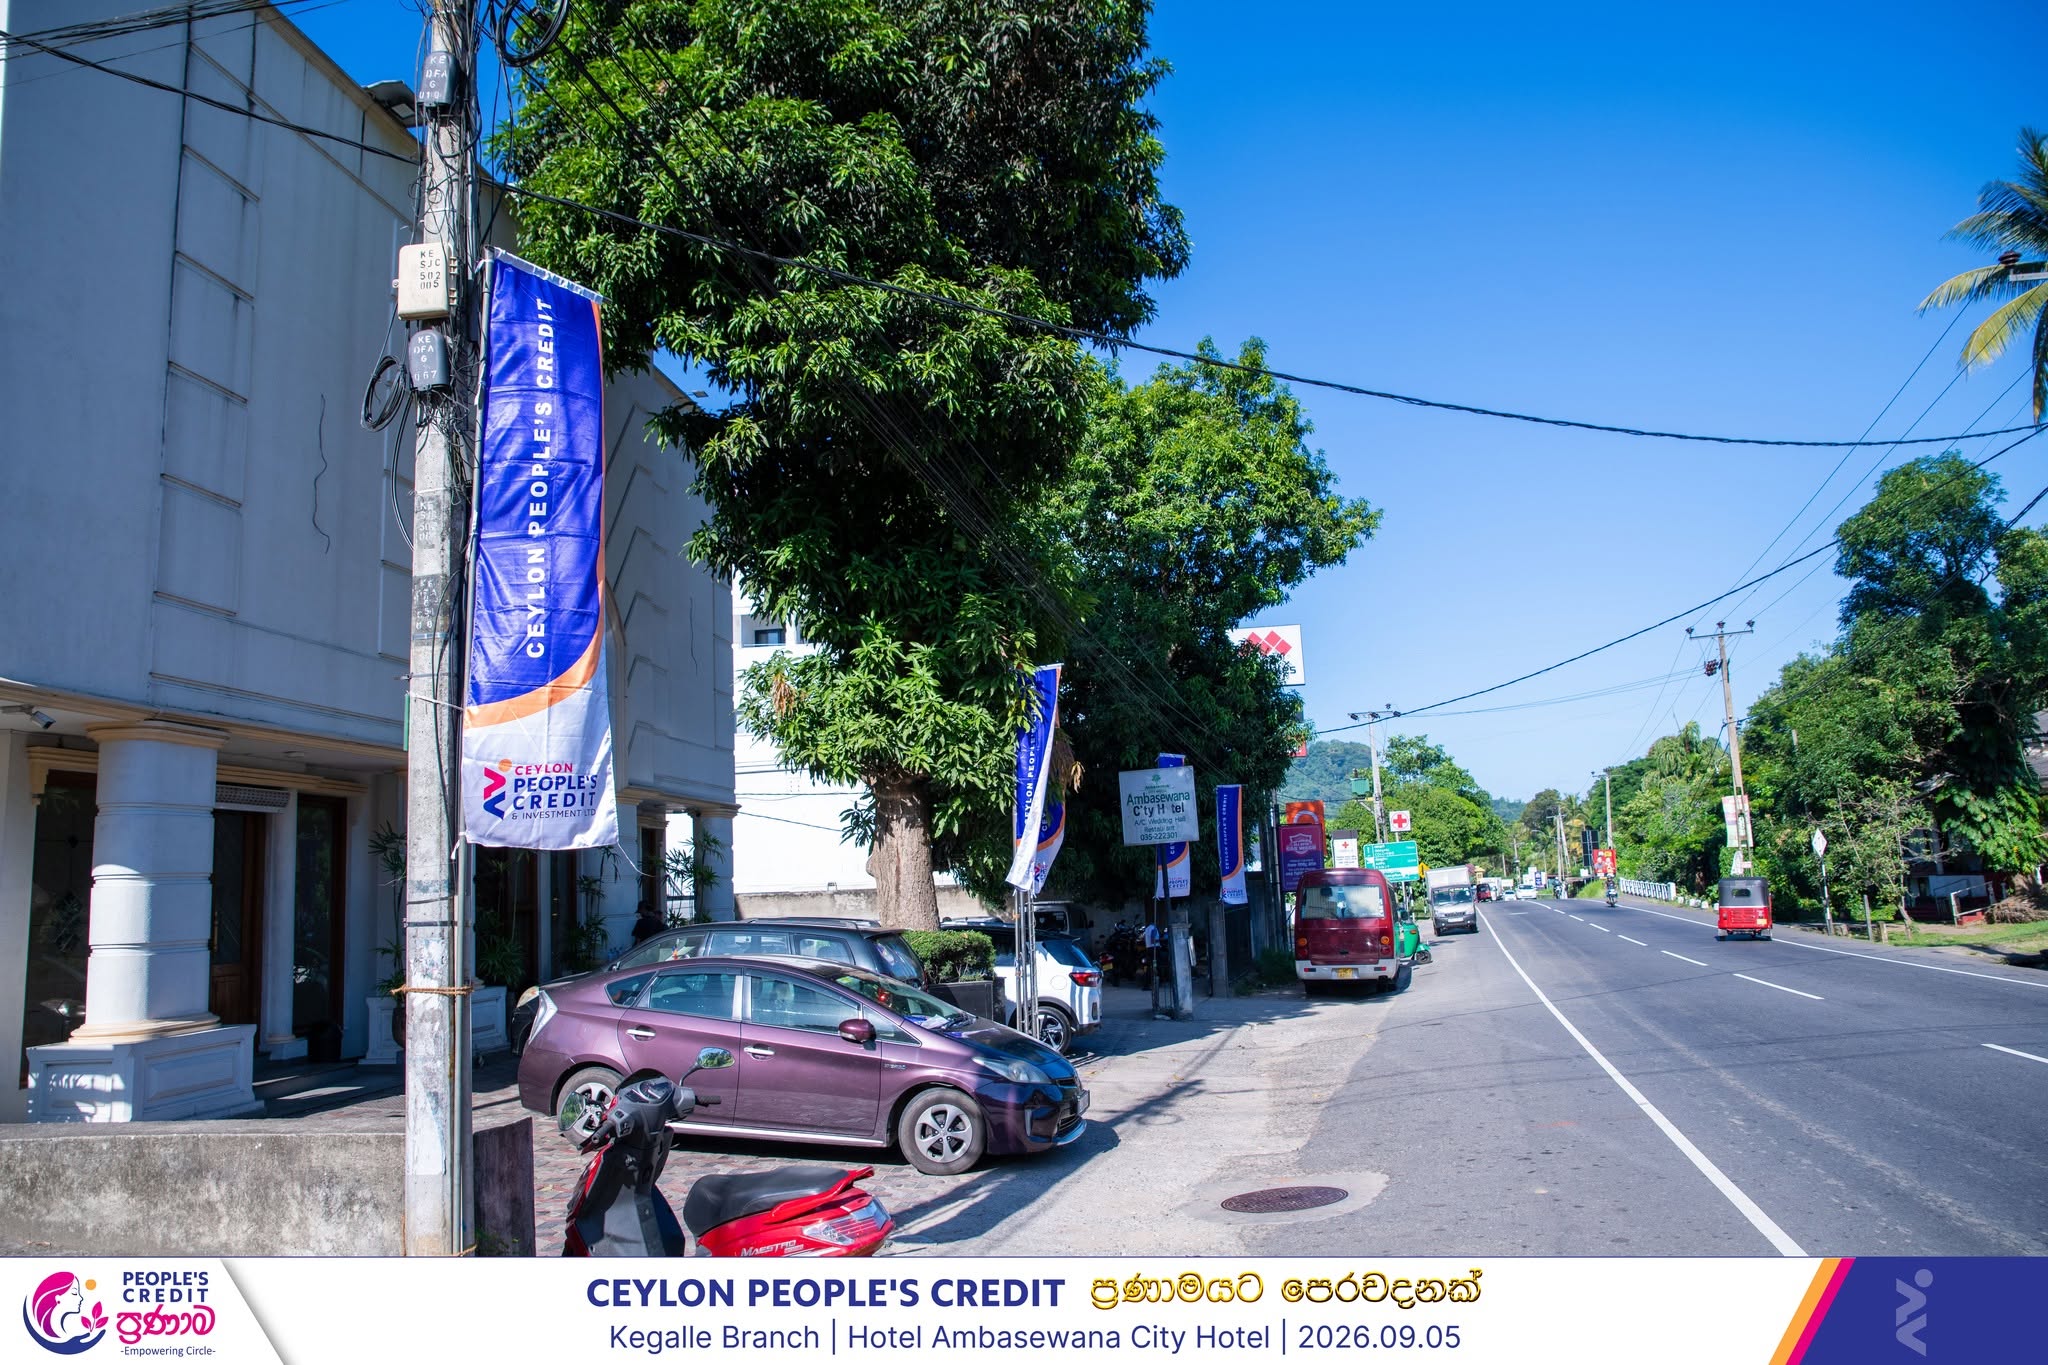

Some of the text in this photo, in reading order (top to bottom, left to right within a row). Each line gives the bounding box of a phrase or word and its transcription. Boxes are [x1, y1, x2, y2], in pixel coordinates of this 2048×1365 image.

[430, 54, 447, 65] KE
[420, 250, 434, 259] KE
[420, 259, 441, 269] SJC
[420, 271, 441, 280] 502
[418, 335, 431, 344] KE
[526, 297, 554, 659] CEYLON PEOPLE'S CREDIT
[515, 763, 573, 776] CEYLON
[513, 774, 598, 793] PEOPLE'S
[512, 792, 596, 811] CREDIT
[1126, 791, 1190, 806] Ambasewana
[511, 808, 597, 820] & INVESTMENT LTD
[1157, 802, 1185, 814] Htel
[741, 1239, 797, 1257] MAESTRO
